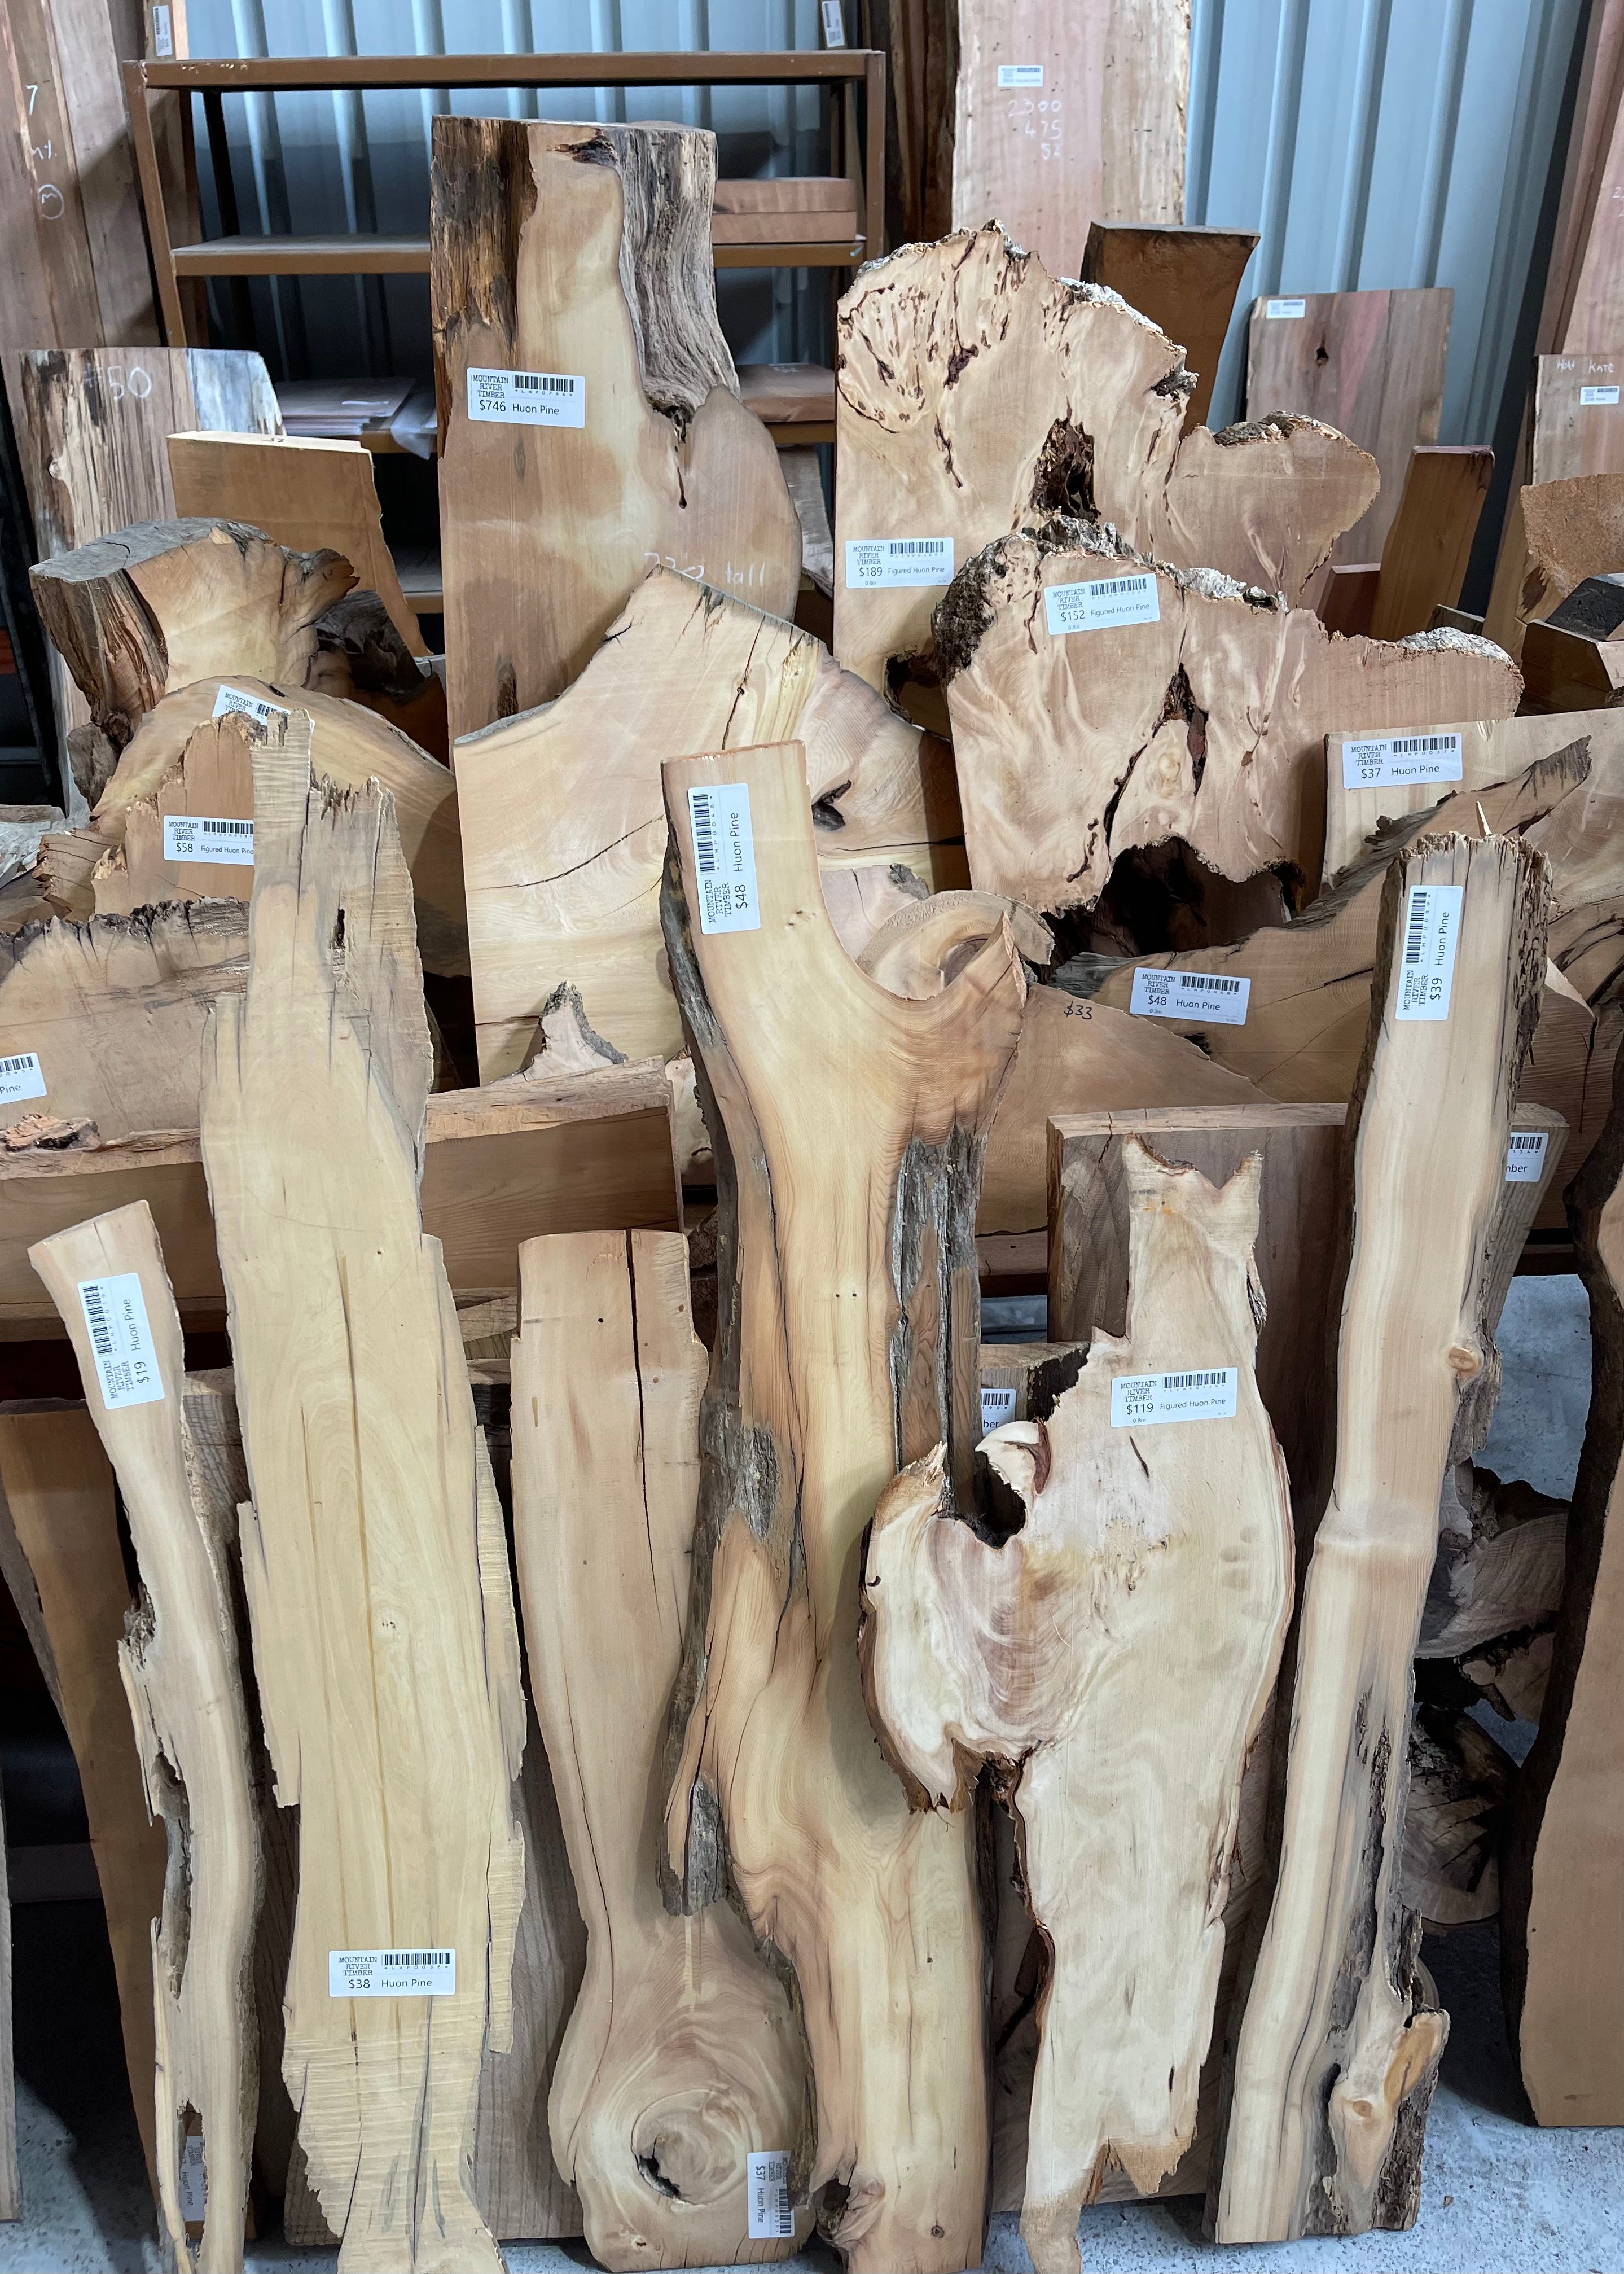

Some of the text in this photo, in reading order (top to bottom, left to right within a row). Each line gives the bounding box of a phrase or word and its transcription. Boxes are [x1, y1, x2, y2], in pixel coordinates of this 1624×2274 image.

[473, 375, 508, 383] MOUNTAIN
[477, 390, 505, 398] TIMBER
[480, 399, 559, 415] $746 Huon Pine
[725, 560, 765, 586] tall
[859, 567, 883, 577] $189
[888, 567, 911, 576] Figured
[1052, 588, 1085, 598] MOUNTAIN
[1057, 602, 1083, 611] TIMBER
[1061, 610, 1085, 622] $152
[1091, 607, 1114, 617] Figured
[225, 693, 253, 707] MOUNTAIN
[228, 700, 246, 711] RIVER
[1351, 744, 1387, 753] MOUNTAIN
[1361, 768, 1381, 779] $37
[1392, 767, 1416, 775] Huon
[177, 842, 193, 853] $58
[729, 813, 749, 909] $48 Huon Pine
[705, 879, 716, 923] MOUNTAIN
[714, 886, 723, 914] RIVER
[722, 882, 732, 917] TIMBER
[1429, 912, 1450, 1000] $39 Huon Pine
[1142, 974, 1175, 982] MOUNTAIN
[1403, 970, 1414, 1010] MOUNTAIN
[1411, 977, 1421, 1003] RIVER
[1419, 974, 1428, 1006] TIMBER
[1064, 1001, 1092, 1019] $33
[1148, 995, 1221, 1011] $48 Huon Pine
[0, 1085, 20, 1094] Pine
[122, 1299, 150, 1383] $19 Huon Pine
[103, 1360, 118, 1399] MOUNTAIN
[113, 1365, 125, 1390] RIVER
[121, 1361, 134, 1392] TIMBER
[1121, 1381, 1157, 1389] MOUNTAIN
[1126, 1403, 1153, 1415] $119
[1160, 1402, 1187, 1410] Figured
[349, 1979, 370, 1990] $38
[756, 2165, 766, 2180] $37
[182, 2172, 190, 2190] Huon
